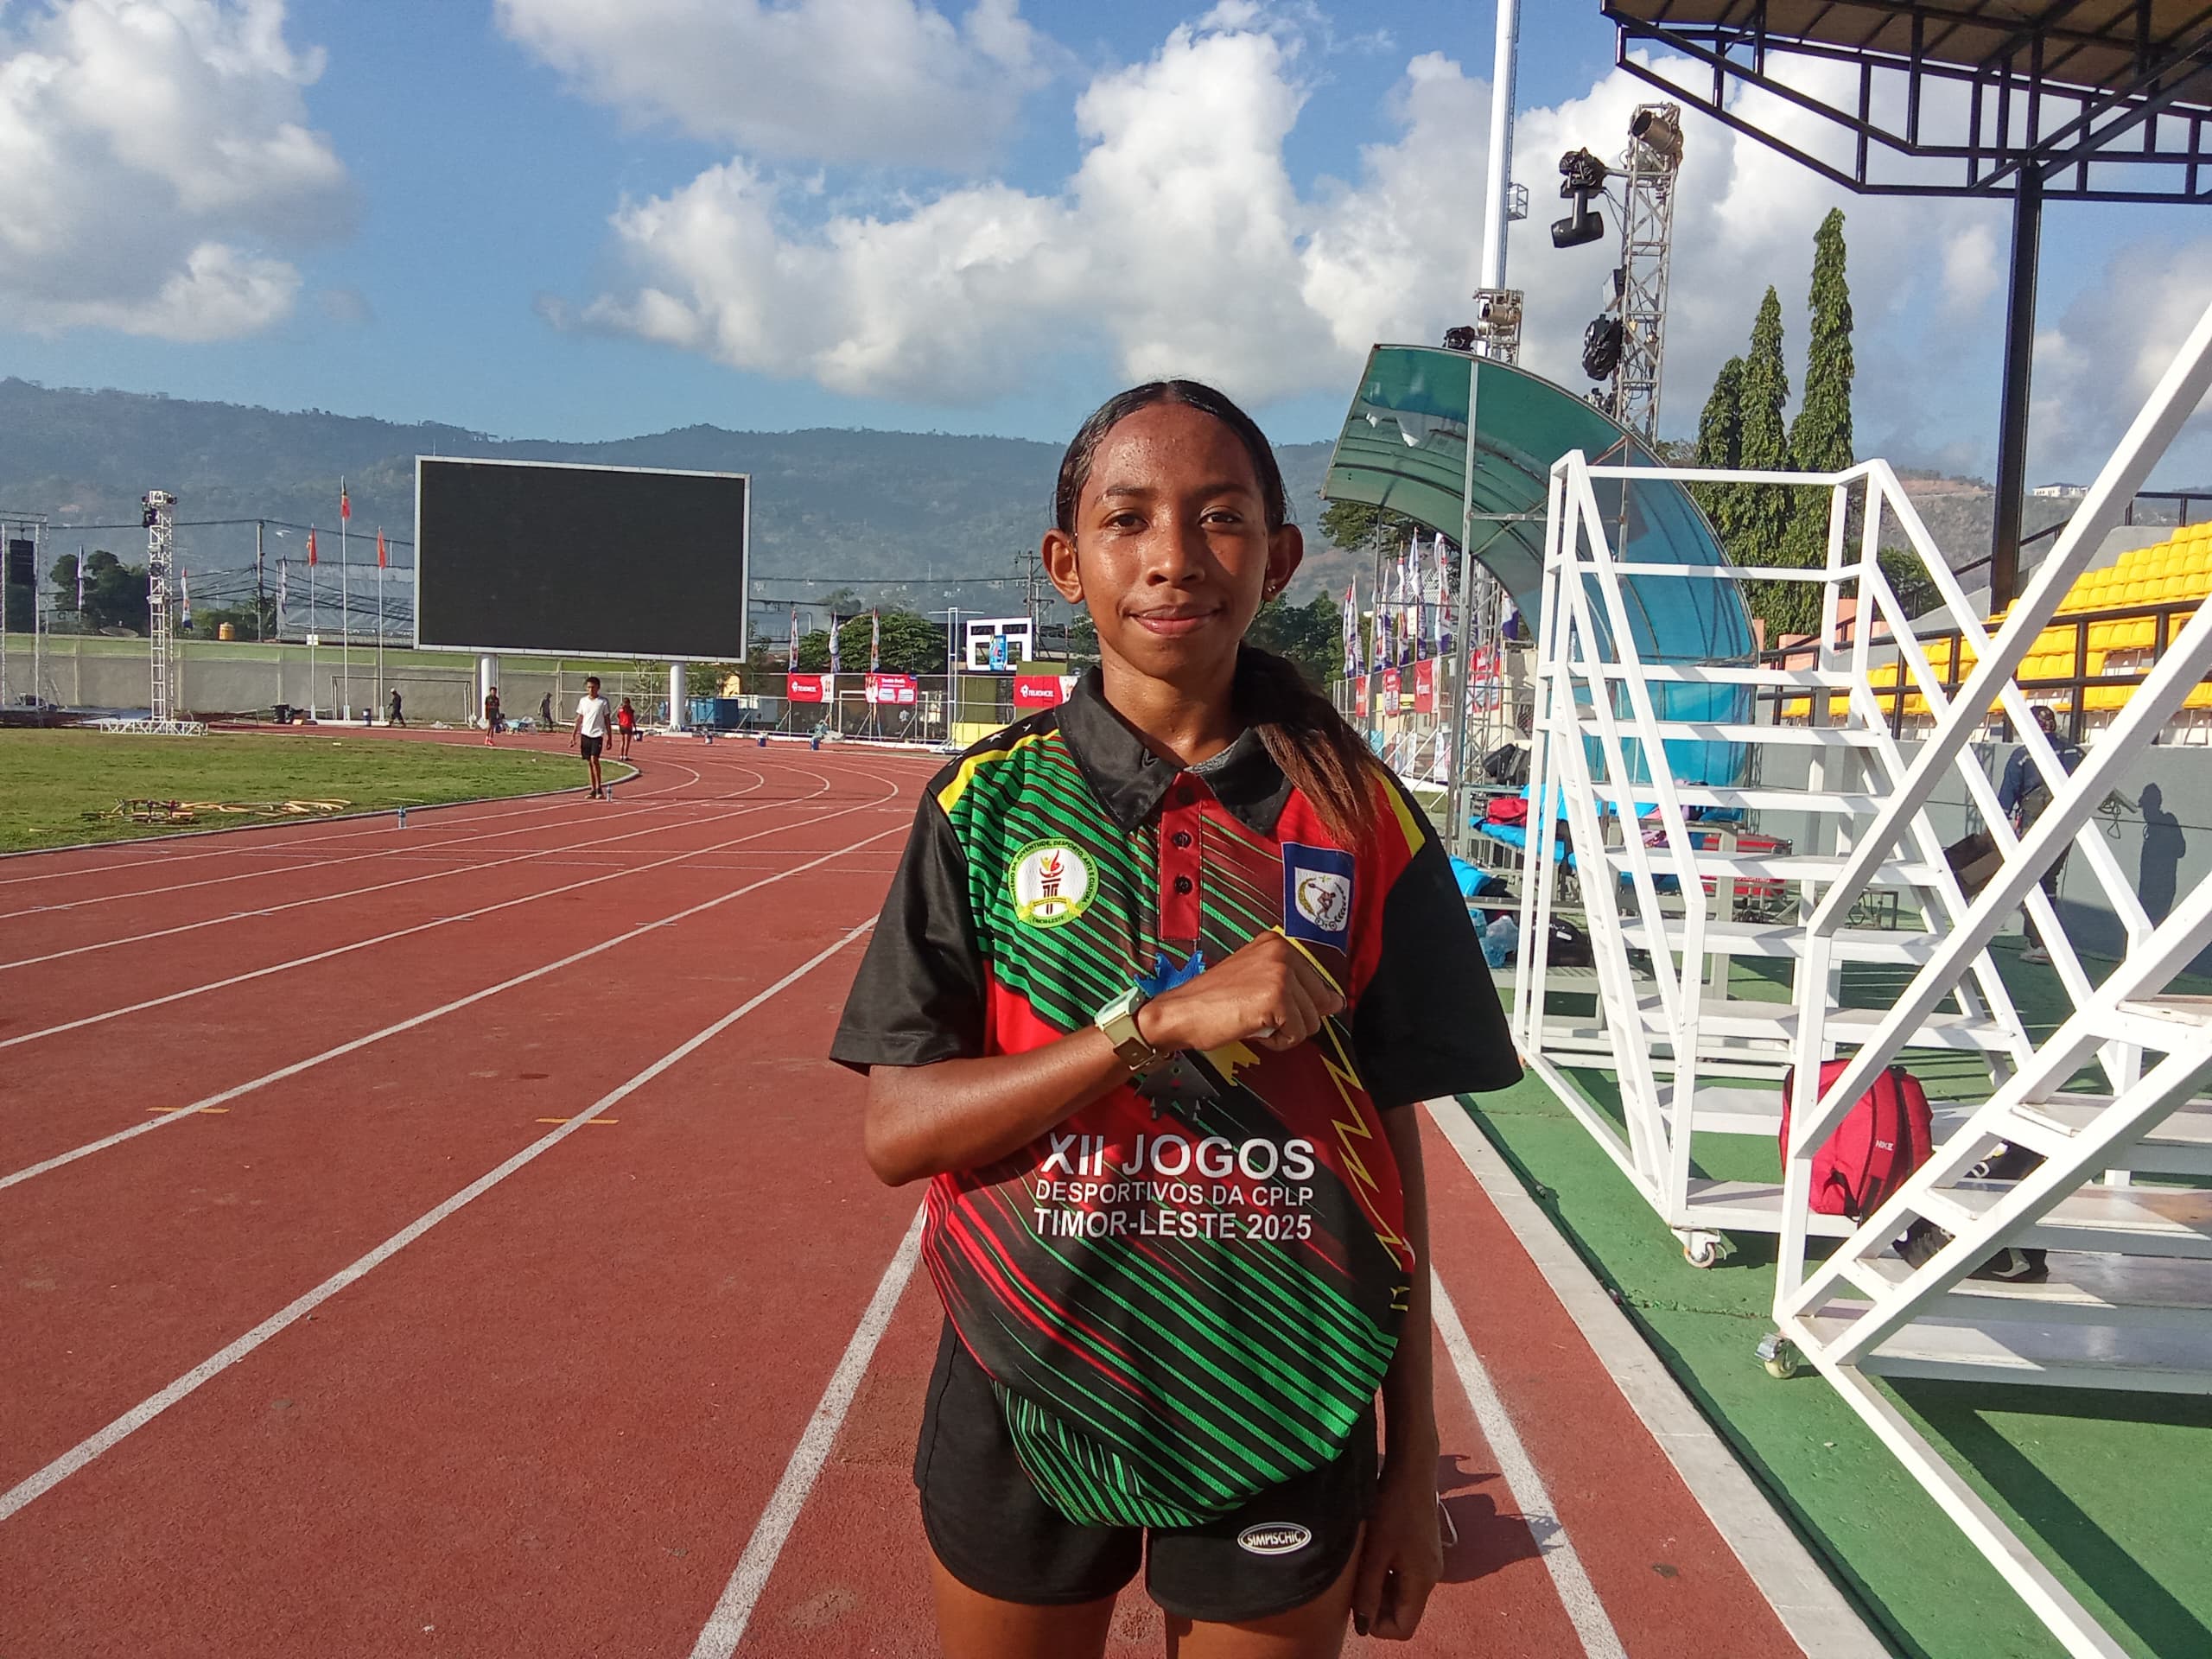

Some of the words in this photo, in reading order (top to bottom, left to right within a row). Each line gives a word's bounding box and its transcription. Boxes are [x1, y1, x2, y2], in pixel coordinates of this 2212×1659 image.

[1040, 1132, 1104, 1176] XII
[1122, 1134, 1316, 1181] JOGOS
[1875, 1140, 1894, 1151] NIKE
[1036, 1179, 1204, 1205] DESPORTIVOS
[1212, 1184, 1245, 1206] DA
[1252, 1185, 1313, 1207] CPLP
[1033, 1207, 1236, 1240] TIMOR-LESTE
[1246, 1214, 1313, 1242] 2025
